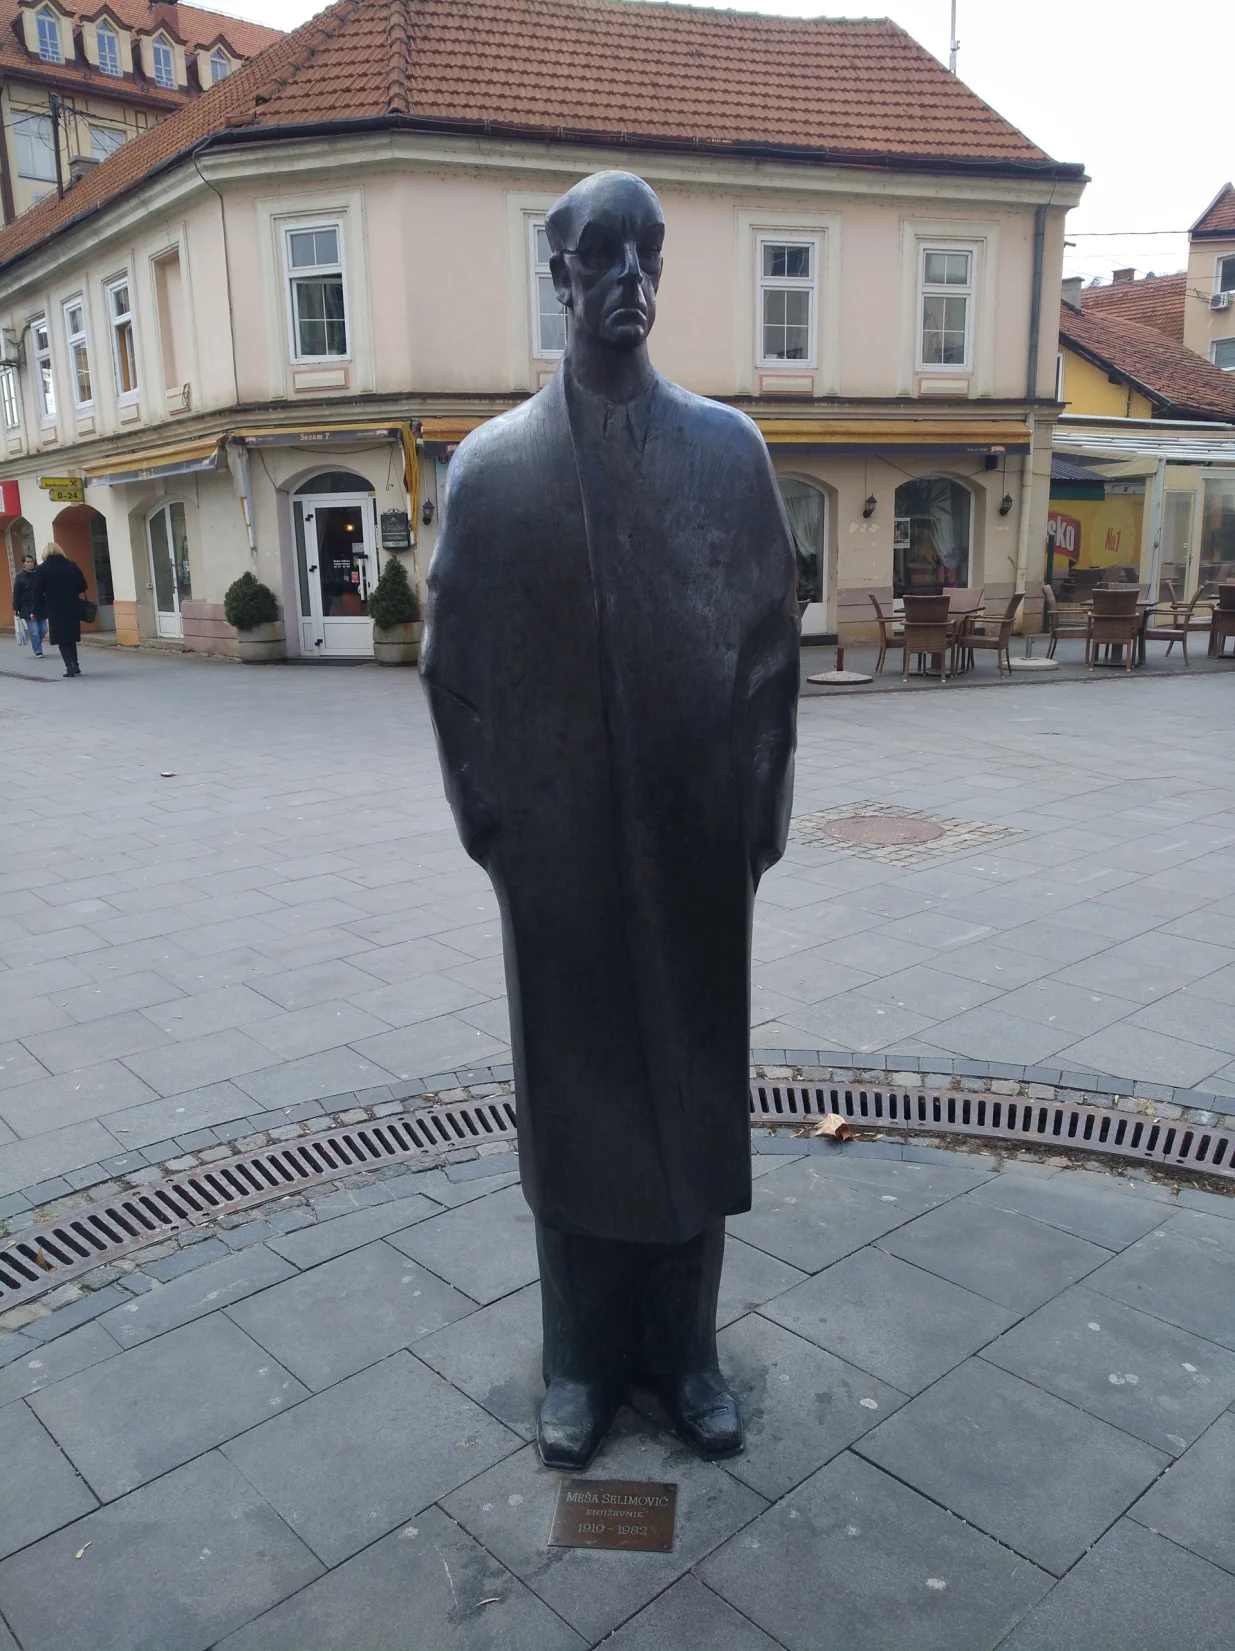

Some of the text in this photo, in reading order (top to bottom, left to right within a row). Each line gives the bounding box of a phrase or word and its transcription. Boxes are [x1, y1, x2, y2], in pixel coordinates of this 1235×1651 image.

[1105, 526, 1122, 552] No.1
[566, 1492, 669, 1507] MEŠA SELIMOVIĆ
[577, 1523, 605, 1534] 1910
[617, 1525, 648, 1536] 1982
